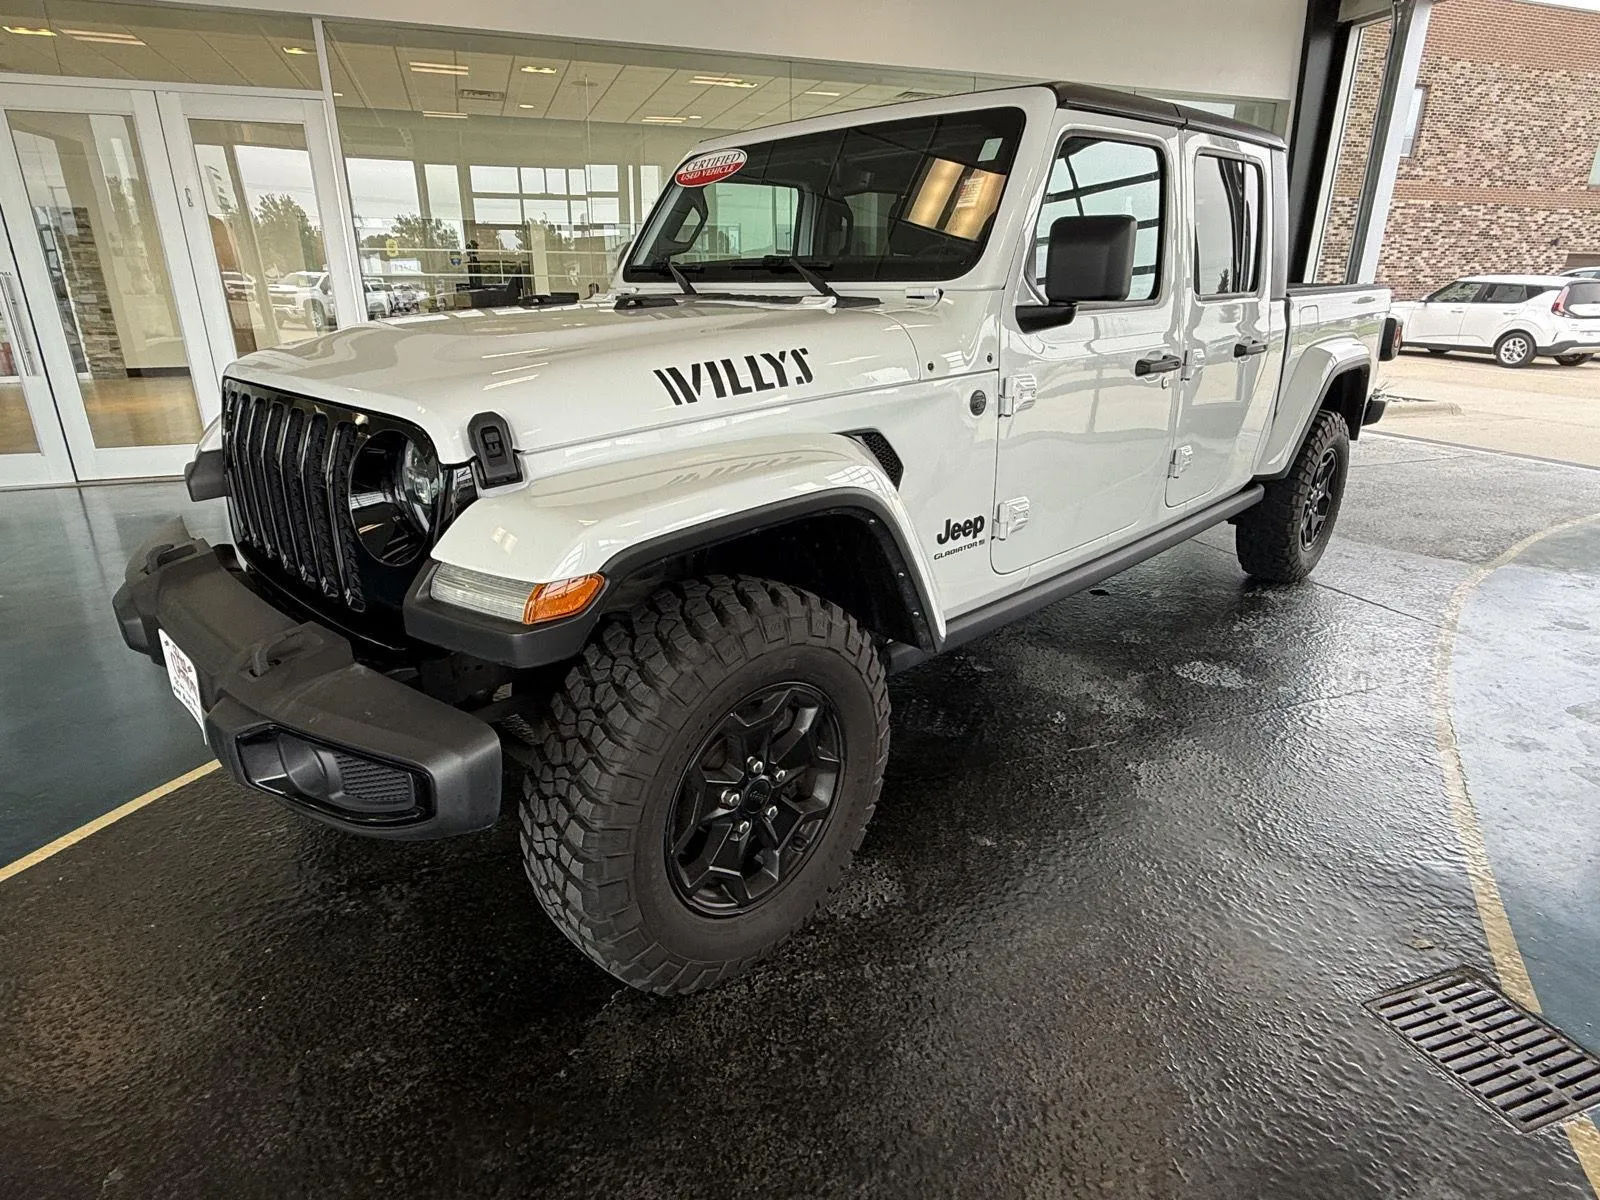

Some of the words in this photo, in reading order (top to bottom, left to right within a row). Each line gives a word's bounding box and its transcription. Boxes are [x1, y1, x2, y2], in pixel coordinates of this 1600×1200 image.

[686, 153, 740, 171] CERTIFIED
[681, 171, 702, 181] USED
[702, 164, 736, 177] VEHICLE
[653, 348, 813, 405] WILLYS
[937, 515, 985, 545] Jeep
[934, 541, 978, 560] GLADIATOR
